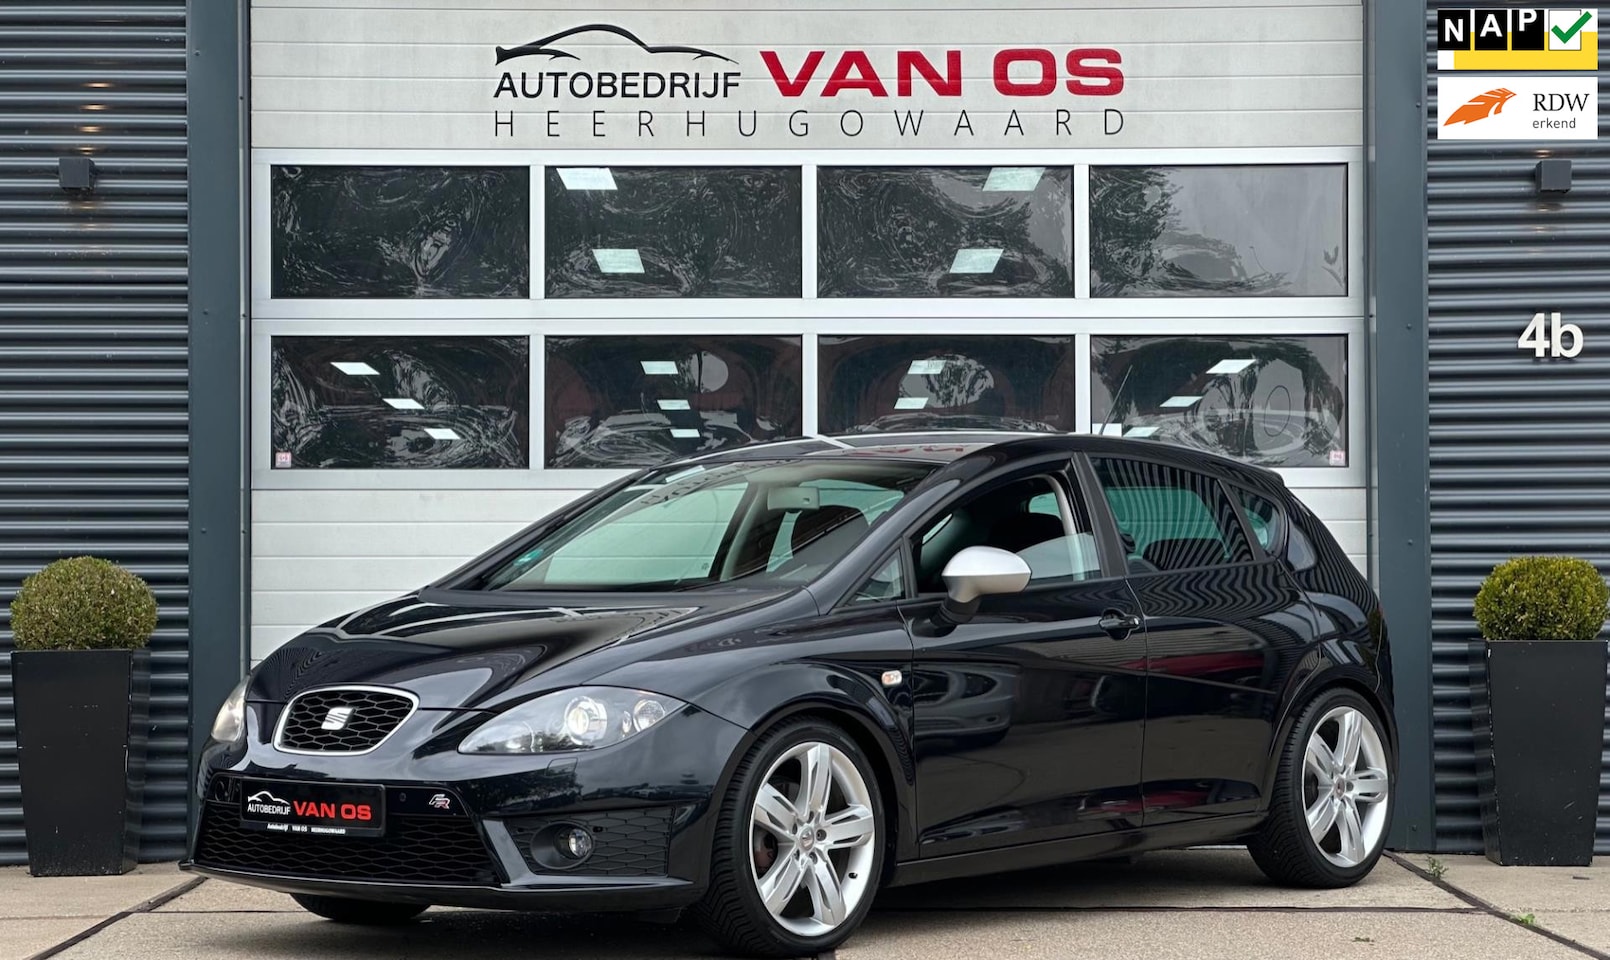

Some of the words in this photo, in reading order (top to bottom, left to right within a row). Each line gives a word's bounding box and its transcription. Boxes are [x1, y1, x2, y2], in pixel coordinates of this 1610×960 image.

[494, 71, 741, 99] AUTOBEDRIJF
[759, 49, 962, 97] VAN
[992, 47, 1125, 97] OS
[494, 109, 1125, 138] HEERHUGOWAARD
[1517, 312, 1584, 358] 4b
[247, 803, 291, 816] AUTOBEDRIJF
[293, 800, 336, 819] VAN
[340, 803, 372, 820] OS
